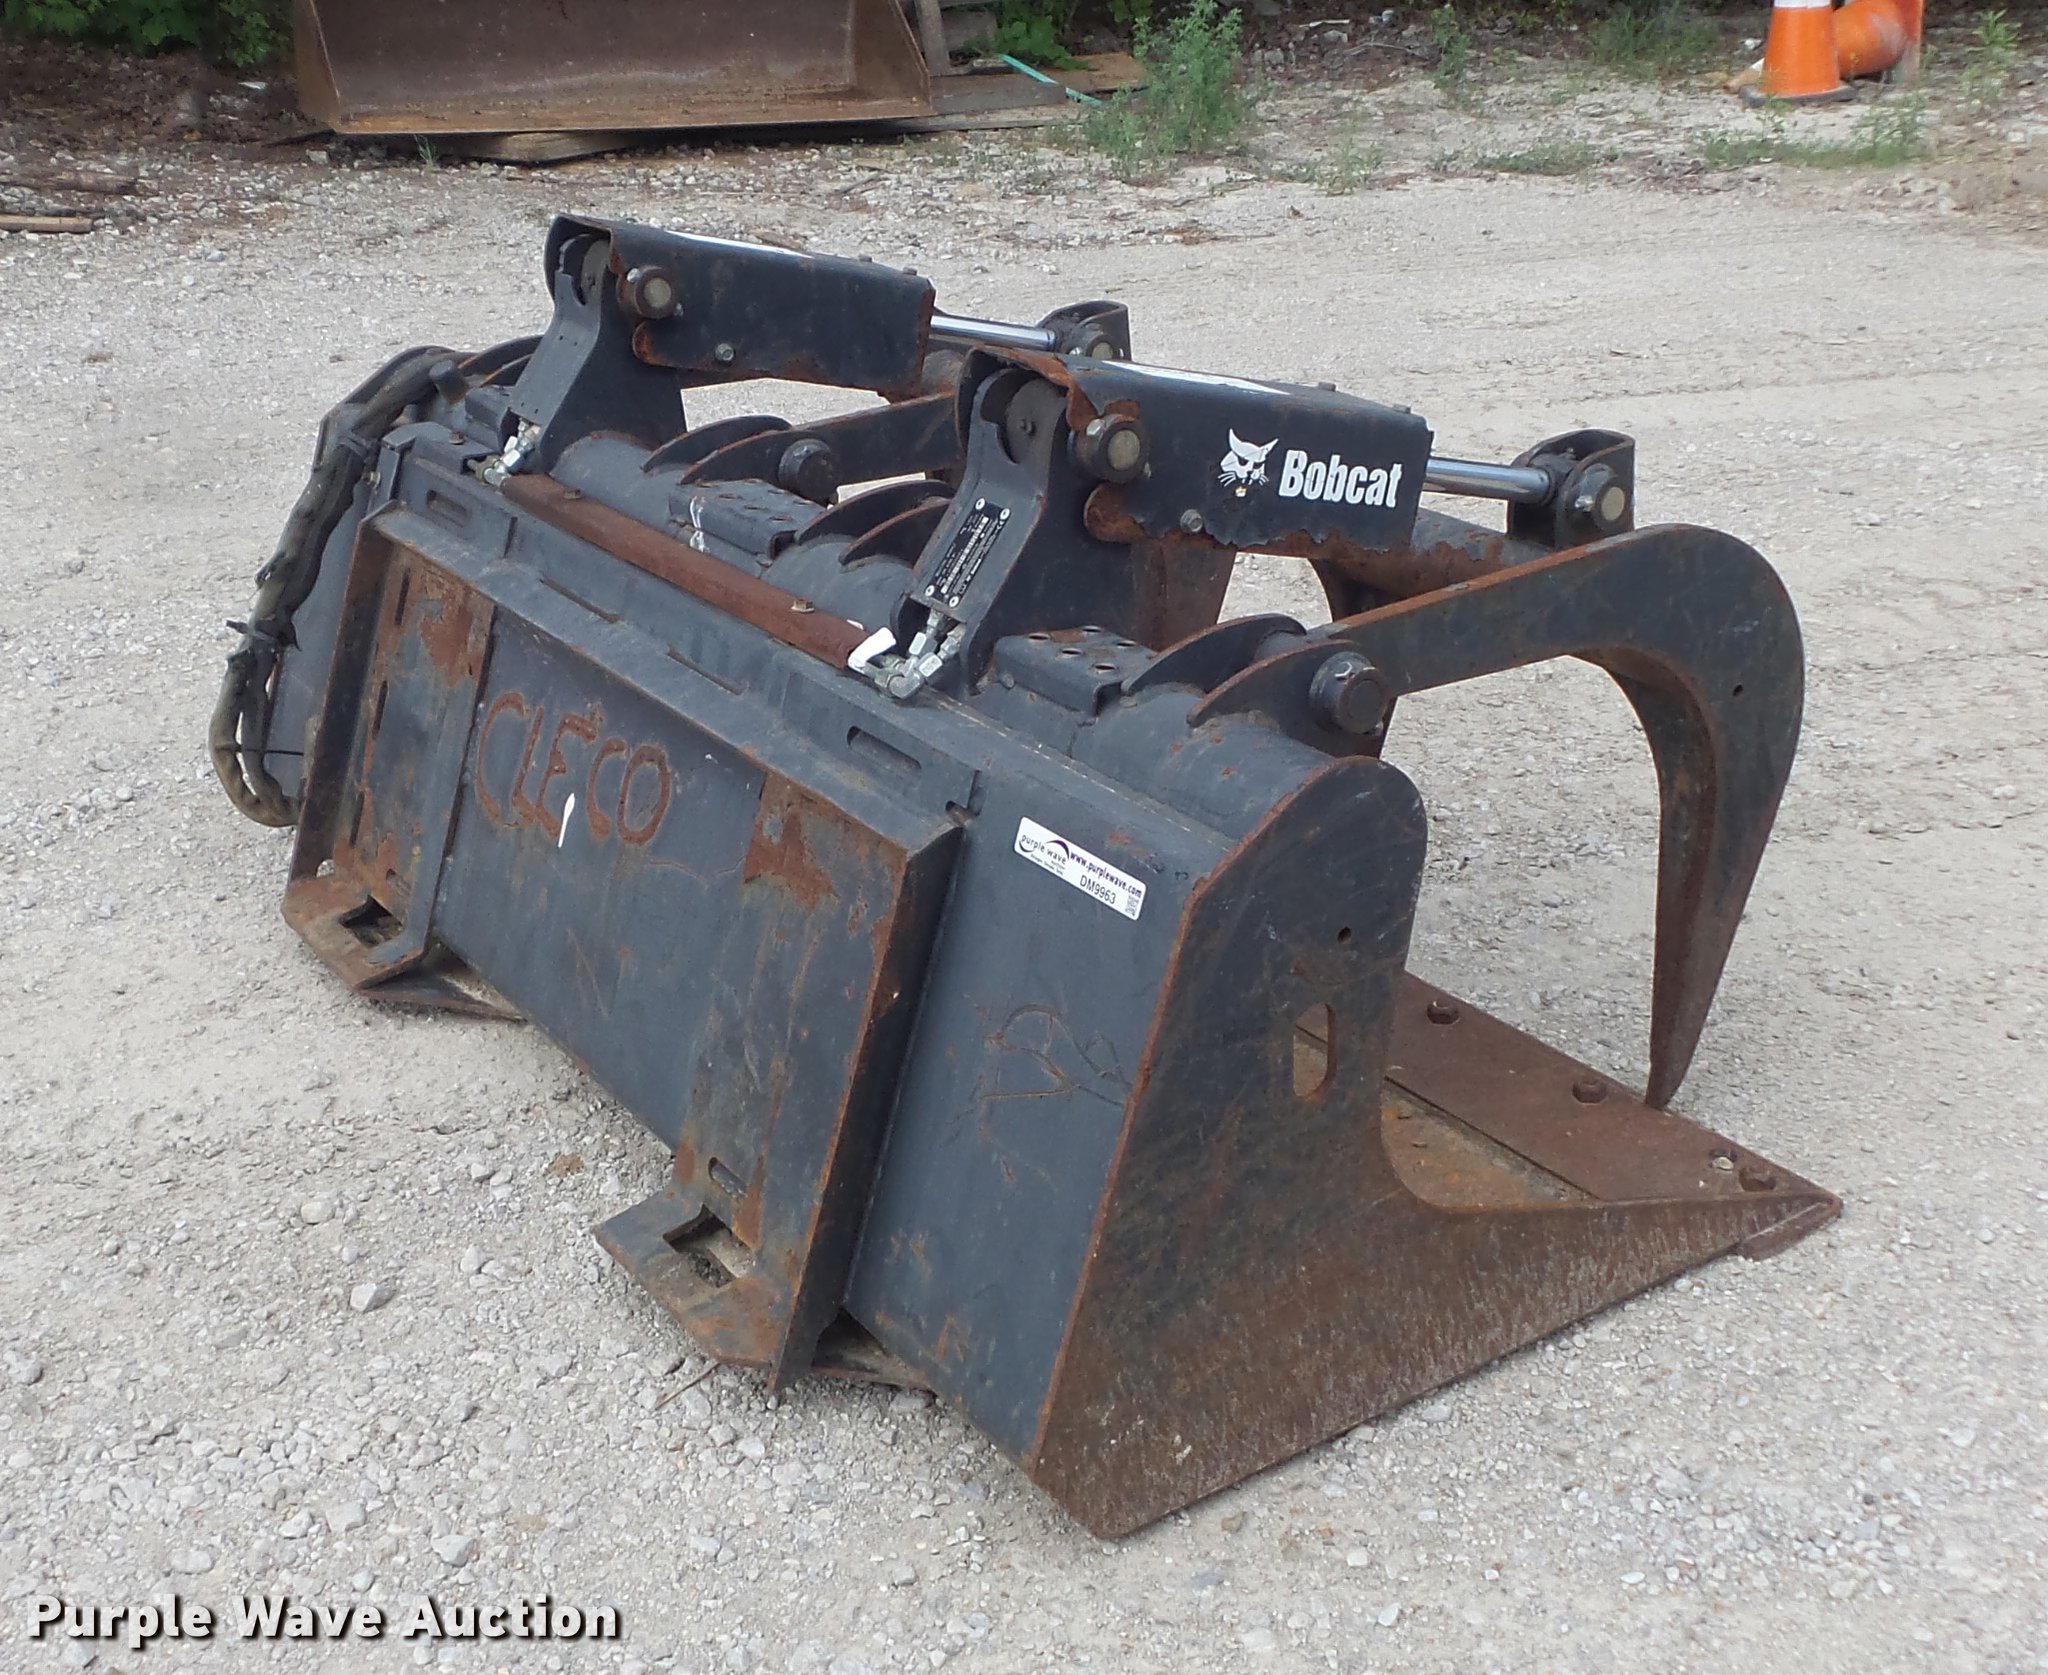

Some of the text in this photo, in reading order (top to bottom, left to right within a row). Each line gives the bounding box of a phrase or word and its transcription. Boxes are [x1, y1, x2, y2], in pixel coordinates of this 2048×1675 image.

[1278, 449, 1402, 508] Bobcat
[475, 691, 672, 845] CLECO
[1021, 834, 1045, 853] purple
[1047, 847, 1067, 865] wave
[1070, 851, 1142, 898] www.purplewave.com
[1080, 875, 1117, 905] DM9963
